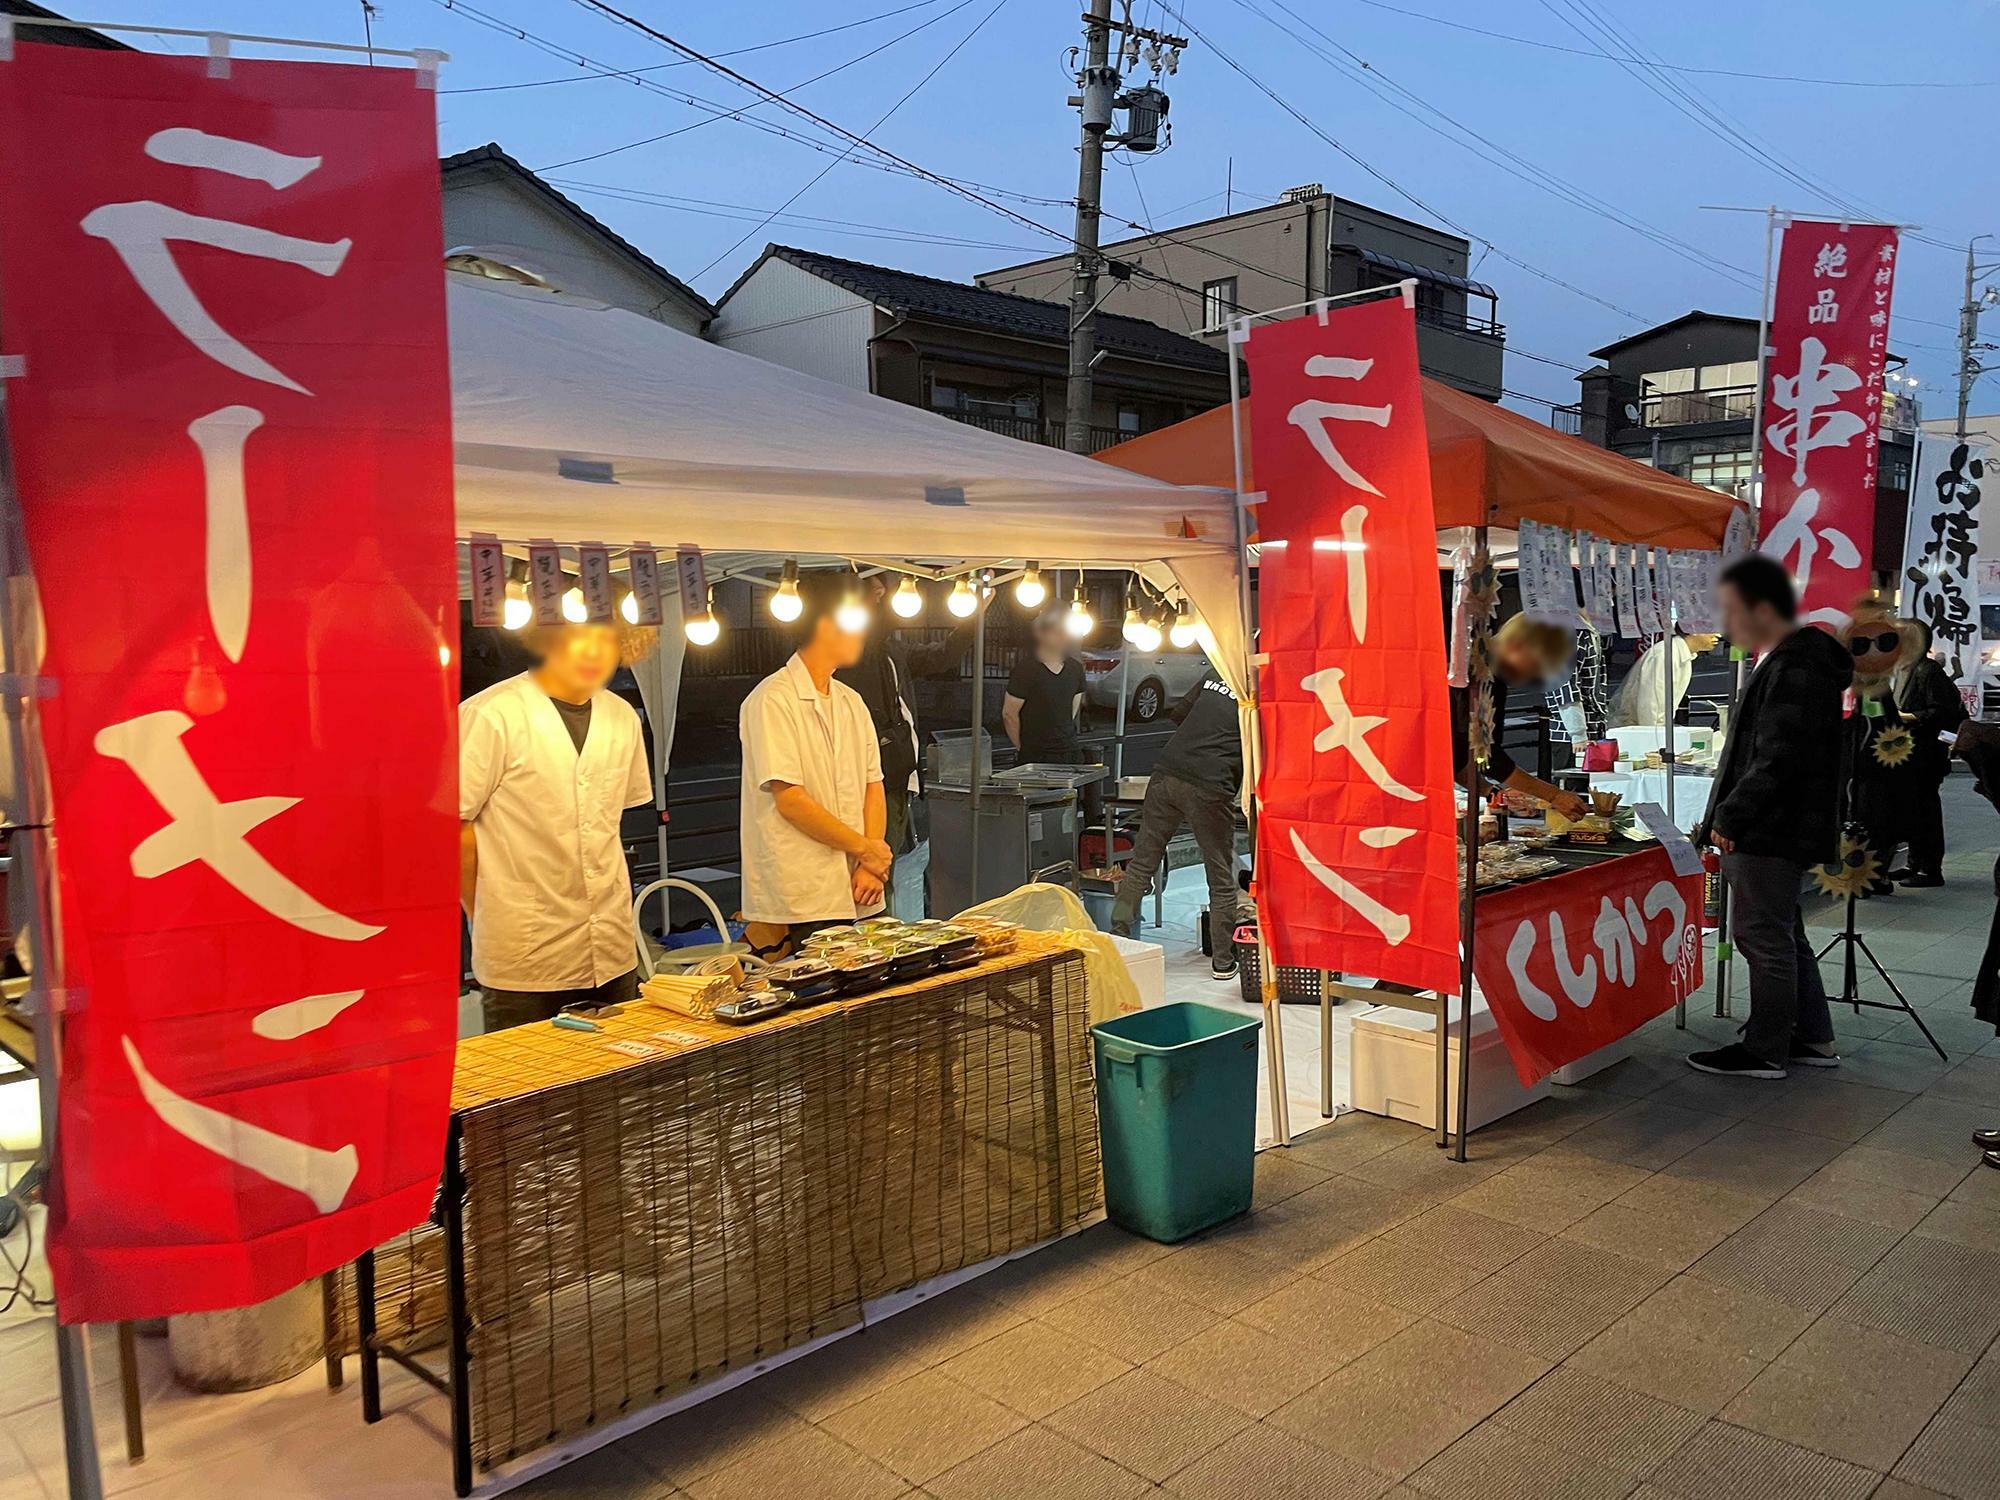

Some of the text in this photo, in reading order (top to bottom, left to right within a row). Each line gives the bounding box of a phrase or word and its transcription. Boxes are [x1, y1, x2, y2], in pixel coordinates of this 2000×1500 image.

[1808, 242, 1848, 325] 絶品
[1862, 243, 1895, 489] 素材と味にこだわりました
[79, 127, 387, 1213] ラーメン
[1286, 353, 1427, 947] ラーメン
[1506, 880, 1687, 1022] くしかつ
